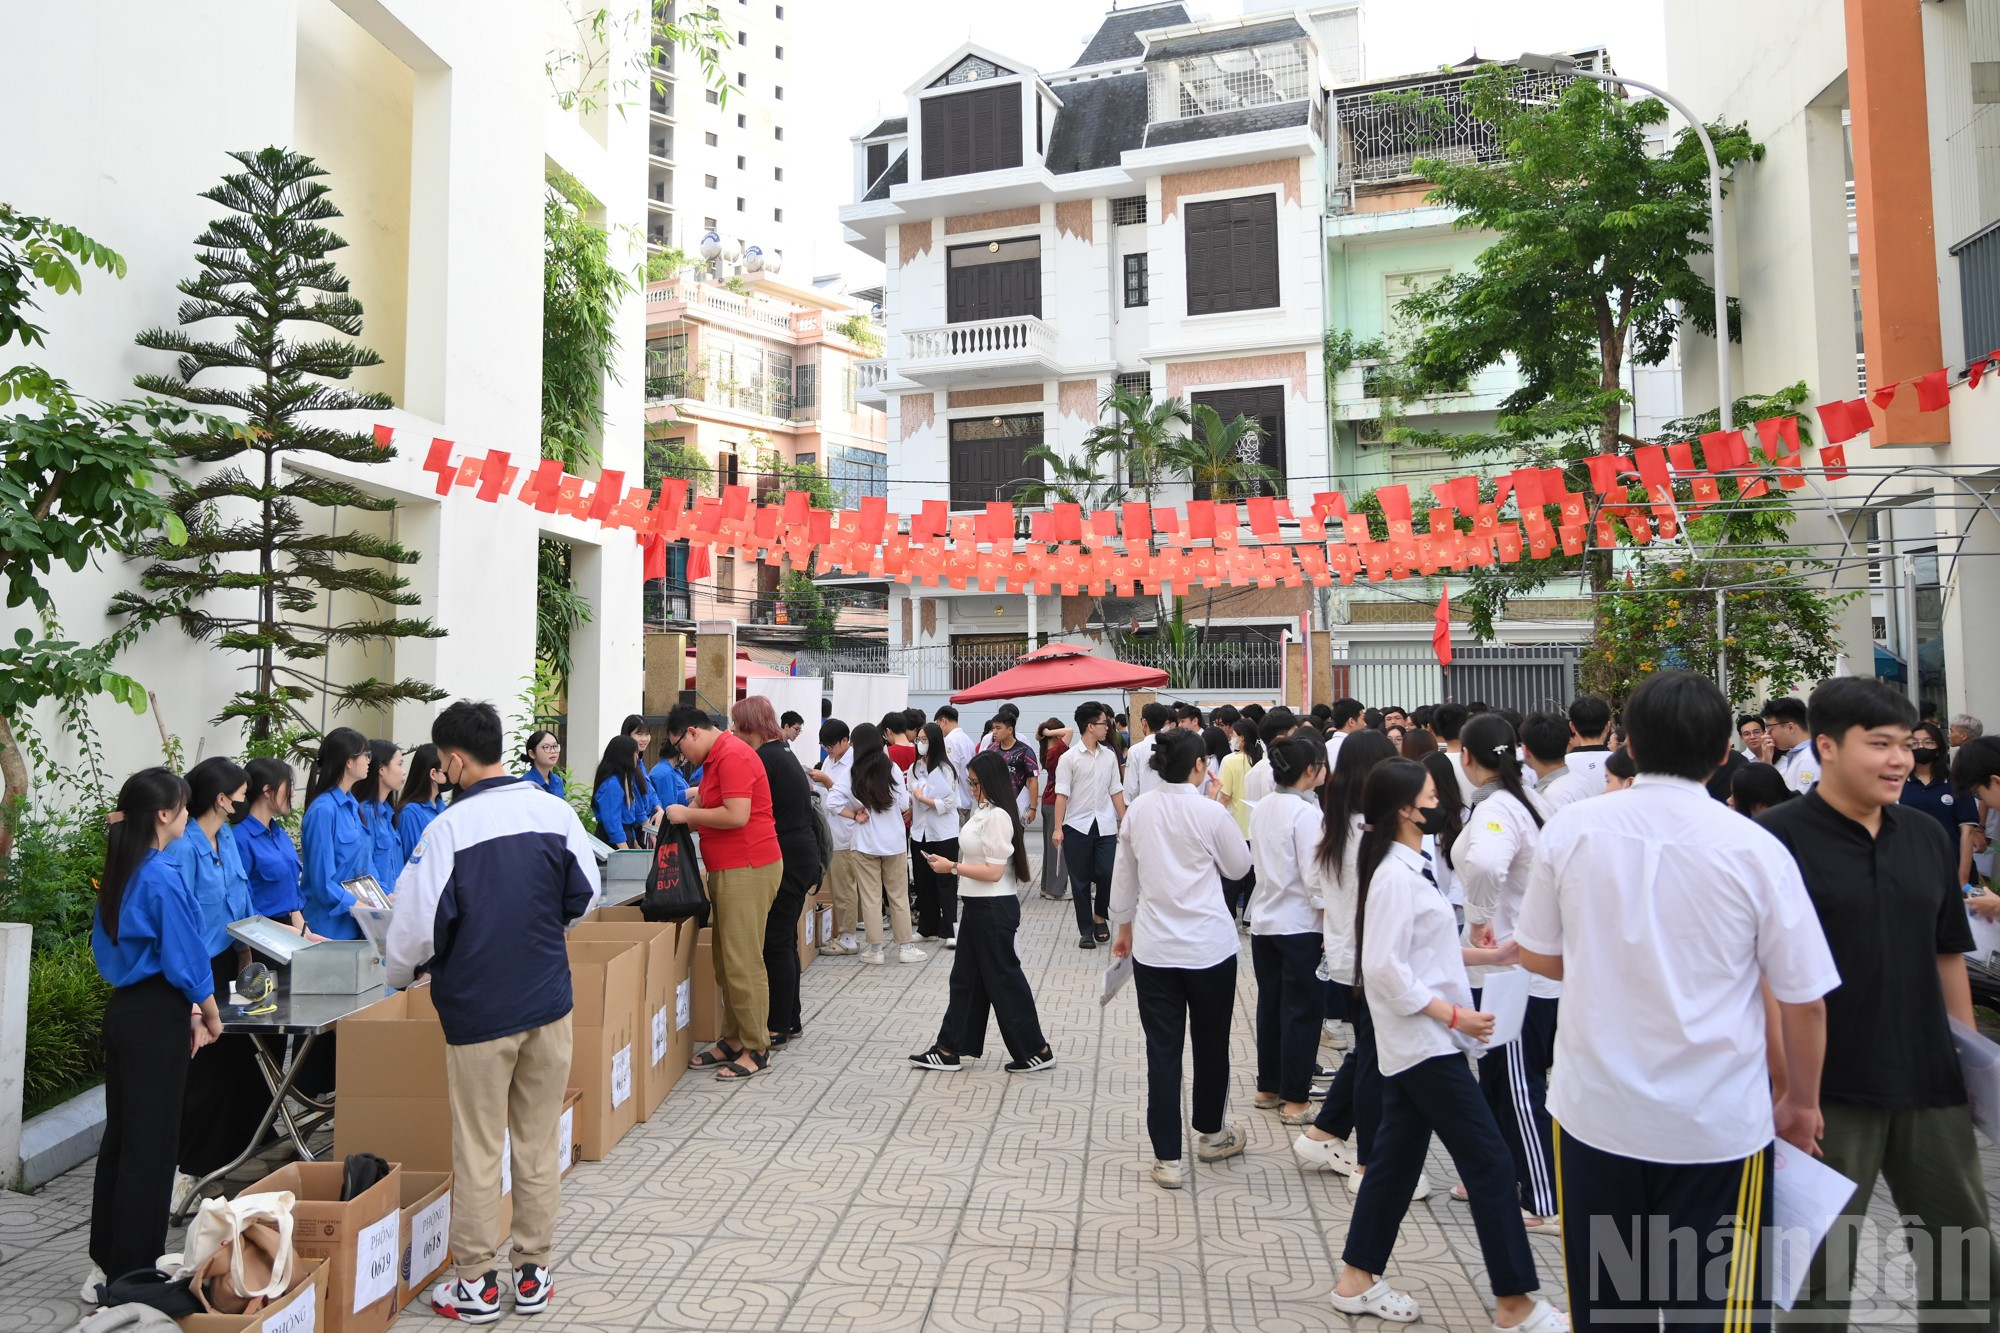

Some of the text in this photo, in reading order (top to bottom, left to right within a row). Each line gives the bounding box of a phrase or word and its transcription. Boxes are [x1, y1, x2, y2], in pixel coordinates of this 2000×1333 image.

[657, 878, 680, 891] BUV
[422, 1205, 445, 1234] PHÒNG
[370, 1223, 395, 1251] PHÒNG
[423, 1231, 442, 1259] 0618
[371, 1252, 391, 1280] 0619
